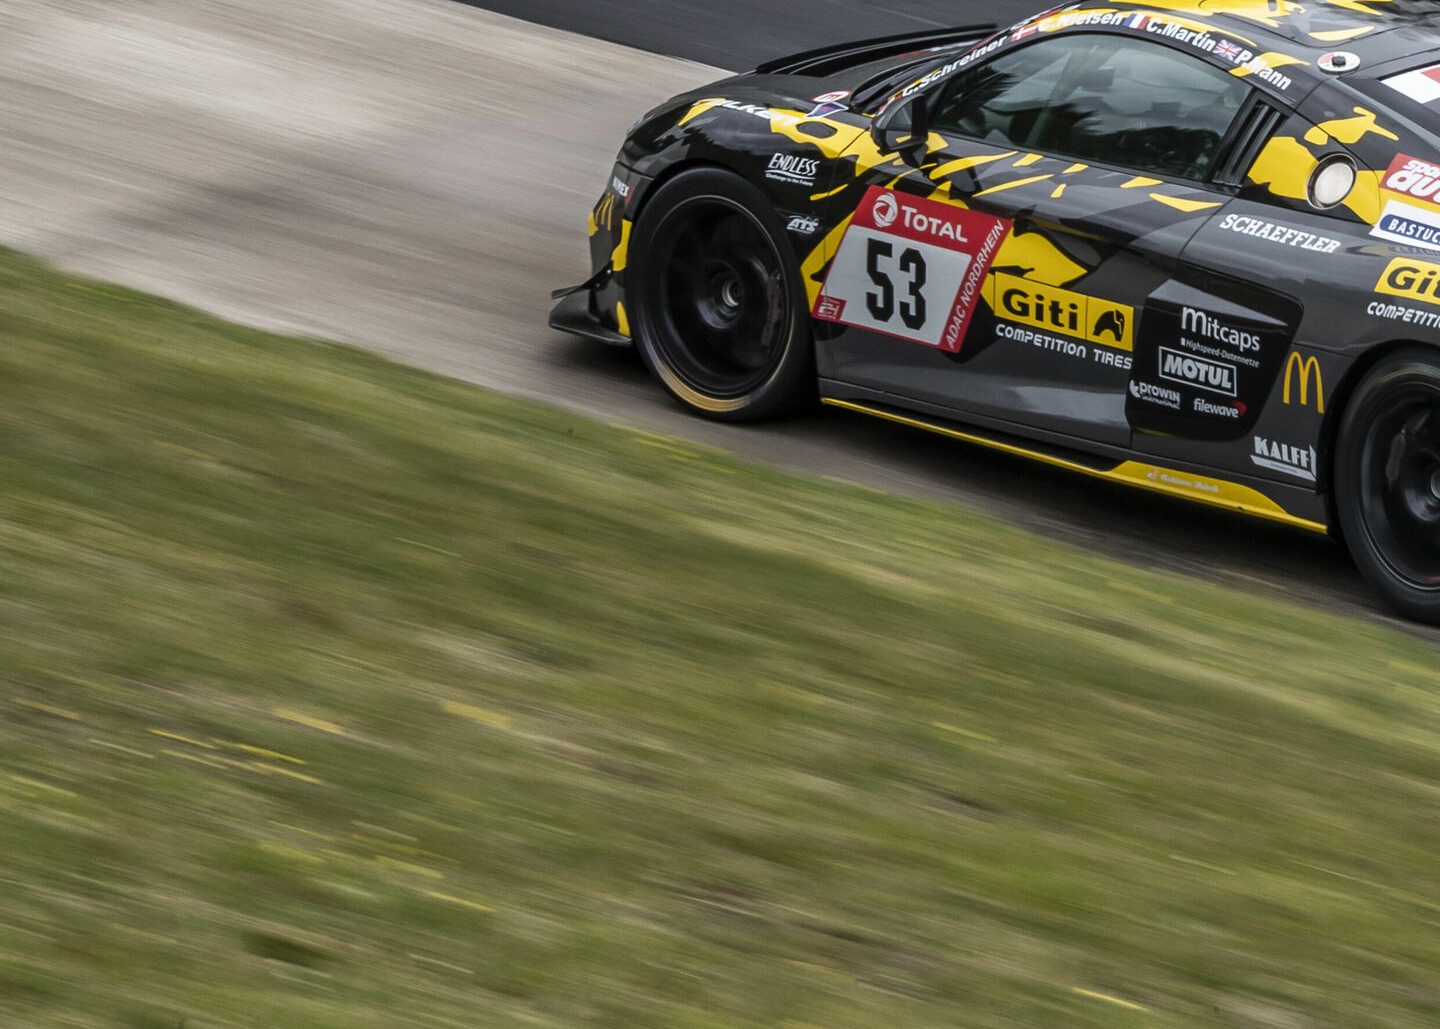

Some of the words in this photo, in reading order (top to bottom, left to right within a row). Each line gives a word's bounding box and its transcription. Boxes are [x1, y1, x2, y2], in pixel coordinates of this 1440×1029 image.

[1037, 12, 1123, 33] C.Nielsen
[1146, 18, 1217, 53] C.Martin
[901, 35, 1008, 98] C.Schreiner
[1234, 51, 1292, 91] P.Mann
[767, 152, 820, 176] ENDLESS
[1219, 213, 1342, 254] SCHAEFFLER
[866, 237, 927, 332] 53
[944, 304, 966, 350] ADAC
[959, 218, 1007, 310] NORDRHEIN
[1002, 288, 1079, 332] Giti
[995, 323, 1087, 360] COMPETITION
[1093, 348, 1134, 371] TIRES
[1163, 353, 1233, 390] MOTUL
[1193, 398, 1240, 419] filewave
[1254, 435, 1310, 469] KALFF
